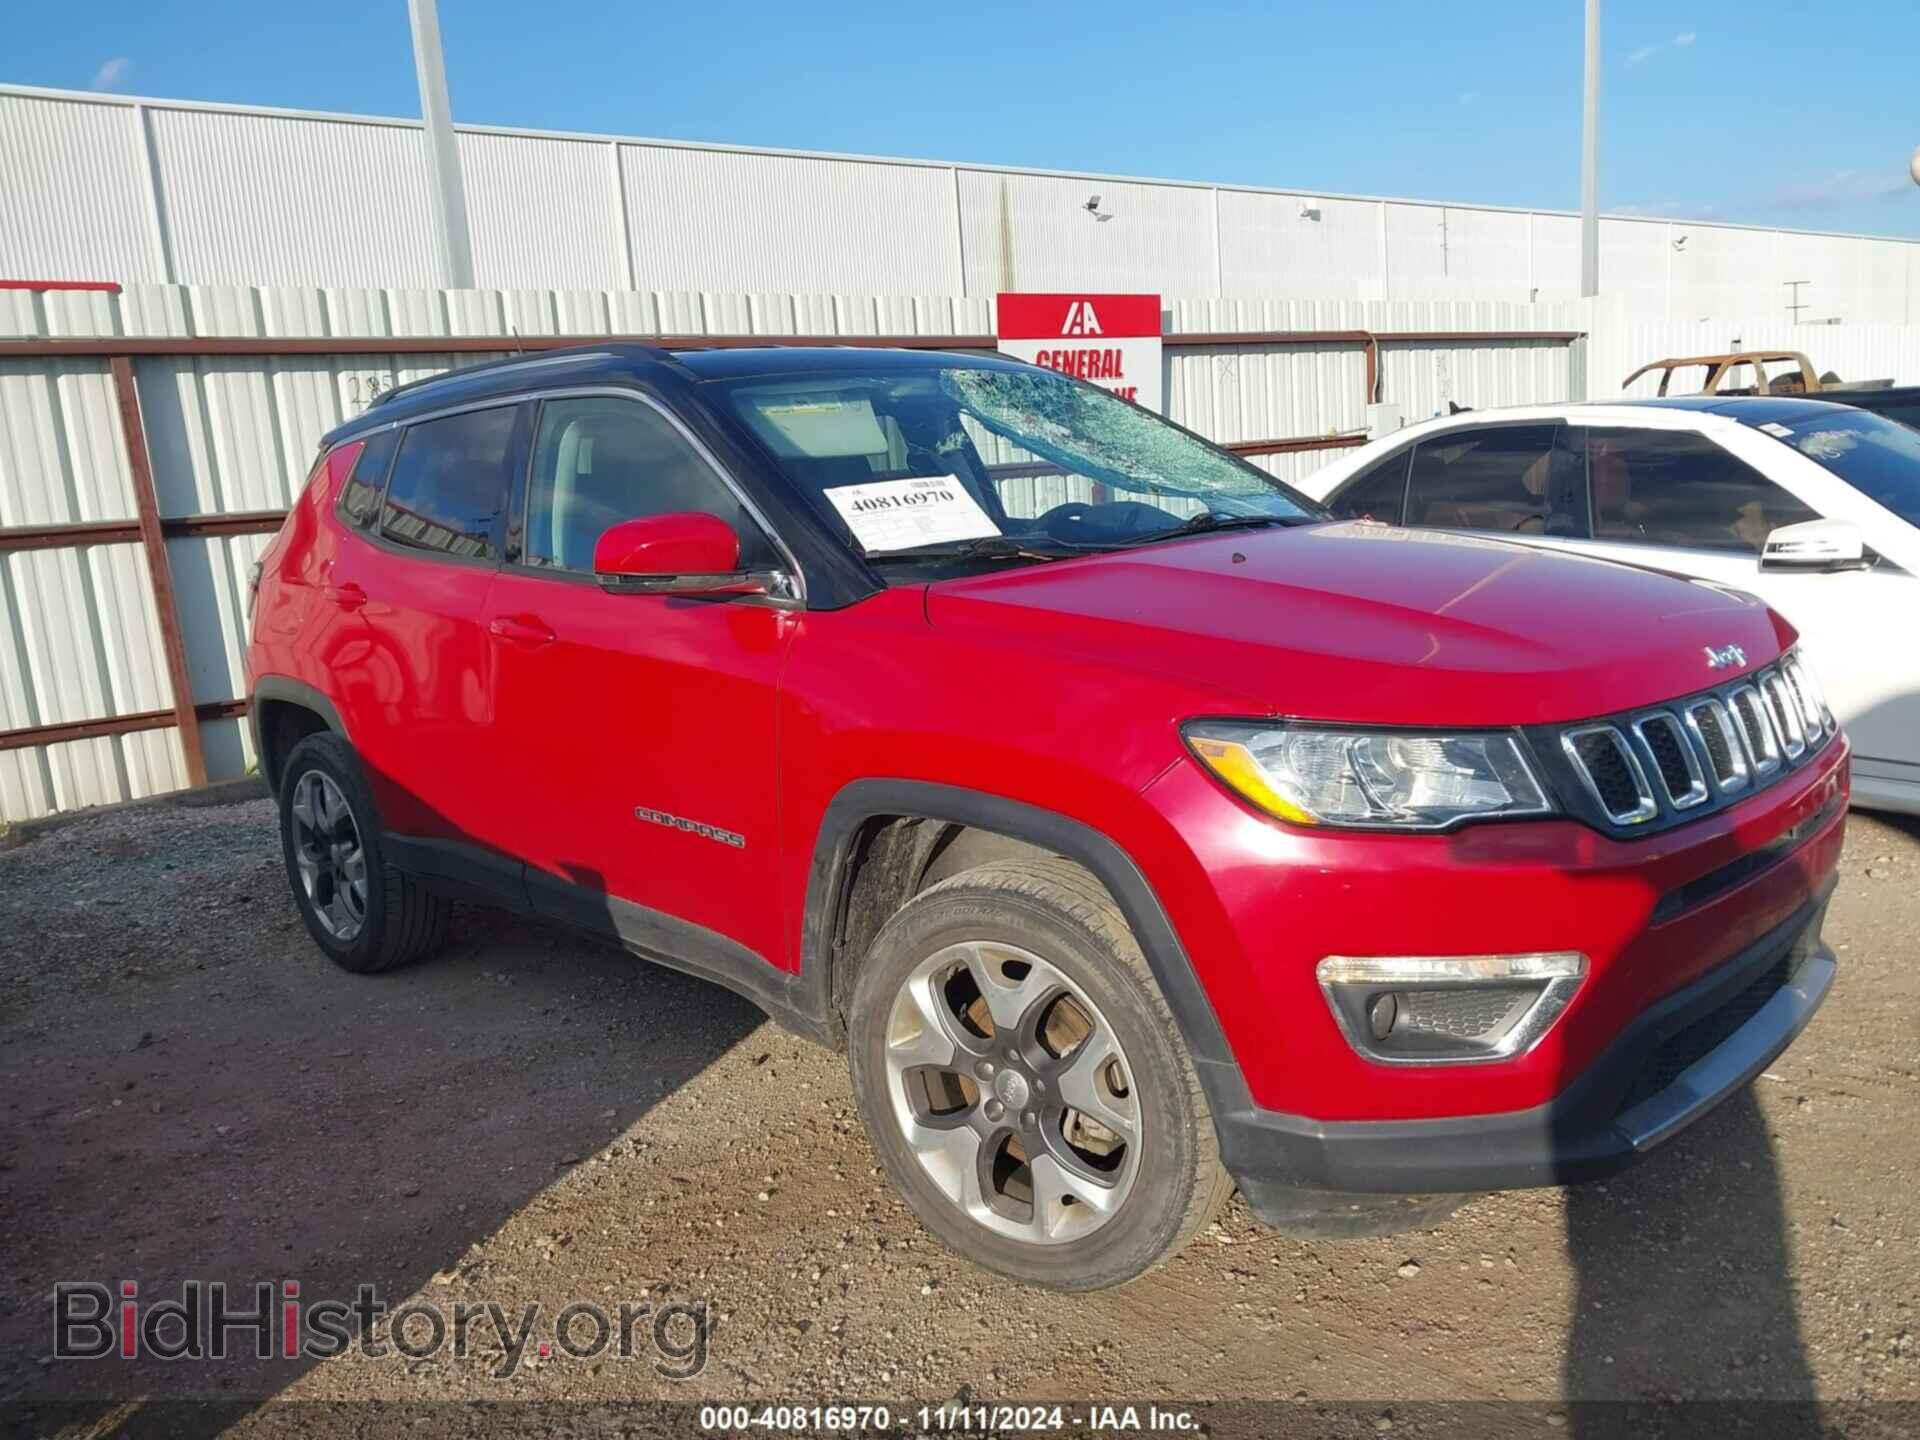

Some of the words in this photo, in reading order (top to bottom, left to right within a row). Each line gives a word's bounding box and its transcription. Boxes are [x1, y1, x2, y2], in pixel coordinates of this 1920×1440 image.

[1036, 349, 1123, 379] GENERAL
[850, 490, 954, 512] 40816970
[635, 806, 745, 848] COMPASS
